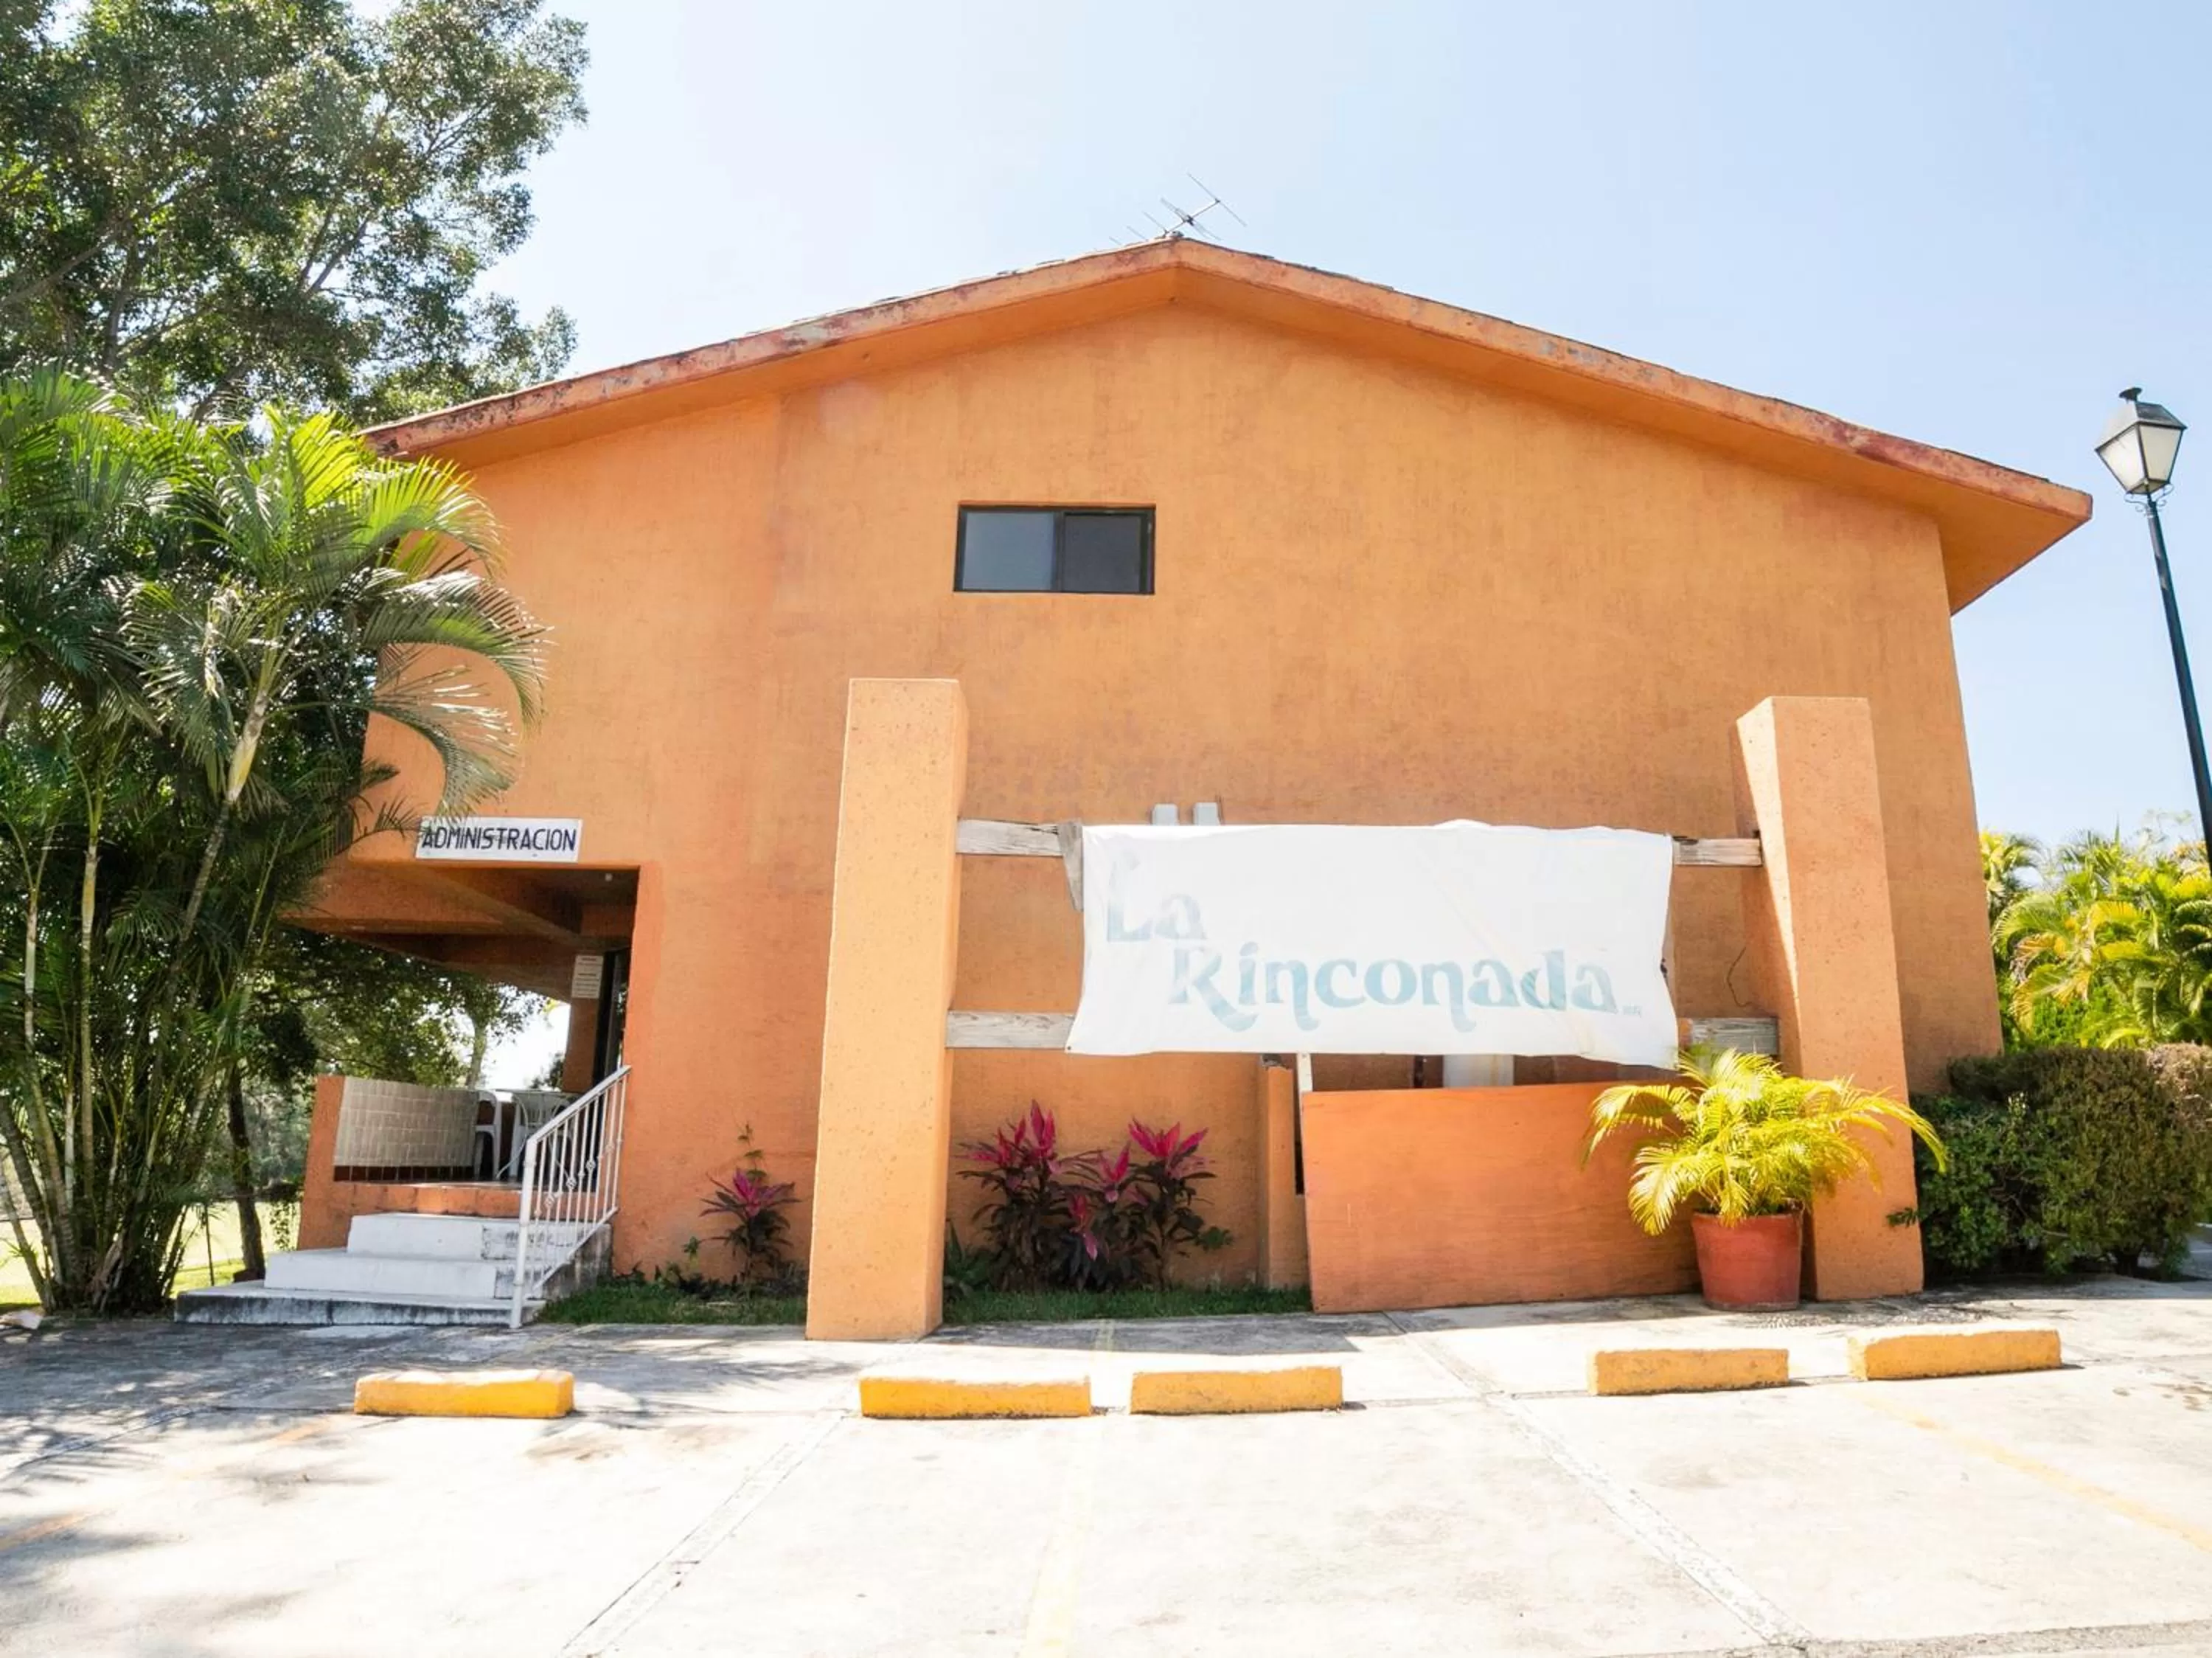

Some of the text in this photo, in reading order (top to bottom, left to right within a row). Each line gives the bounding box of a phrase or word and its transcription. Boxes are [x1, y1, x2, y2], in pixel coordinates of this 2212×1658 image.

[421, 826, 577, 851] ADMINISTRACION
[1106, 848, 1208, 943] La
[1168, 941, 1618, 1033] Rinconada
